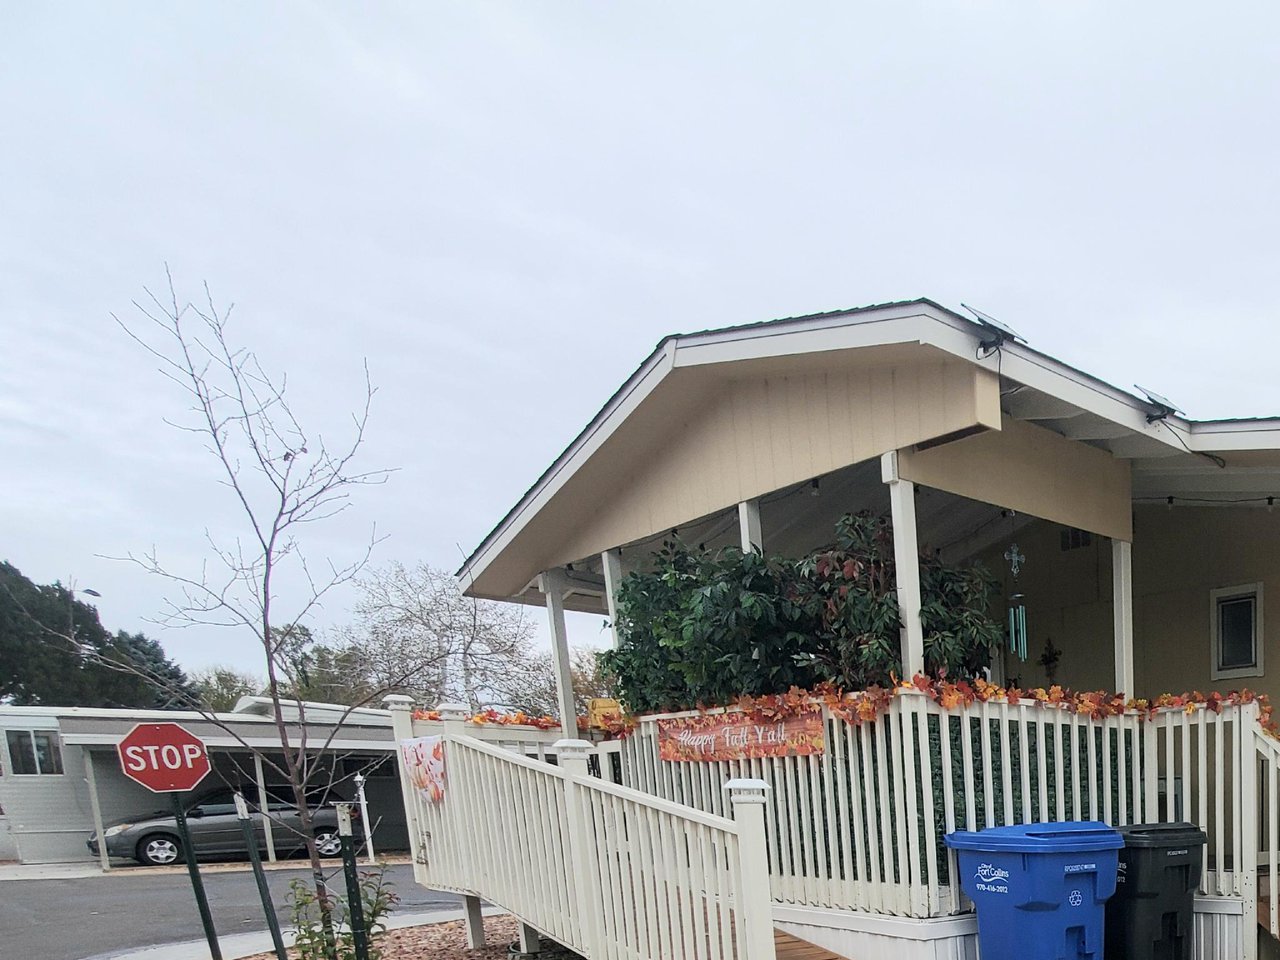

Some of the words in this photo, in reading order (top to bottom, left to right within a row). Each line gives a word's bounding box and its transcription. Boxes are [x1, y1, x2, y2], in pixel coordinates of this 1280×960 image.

[678, 729, 716, 754] Happy
[722, 727, 749, 748] Fall
[754, 722, 787, 744] Y'all
[126, 744, 202, 771] STOP
[978, 866, 990, 876] Fort
